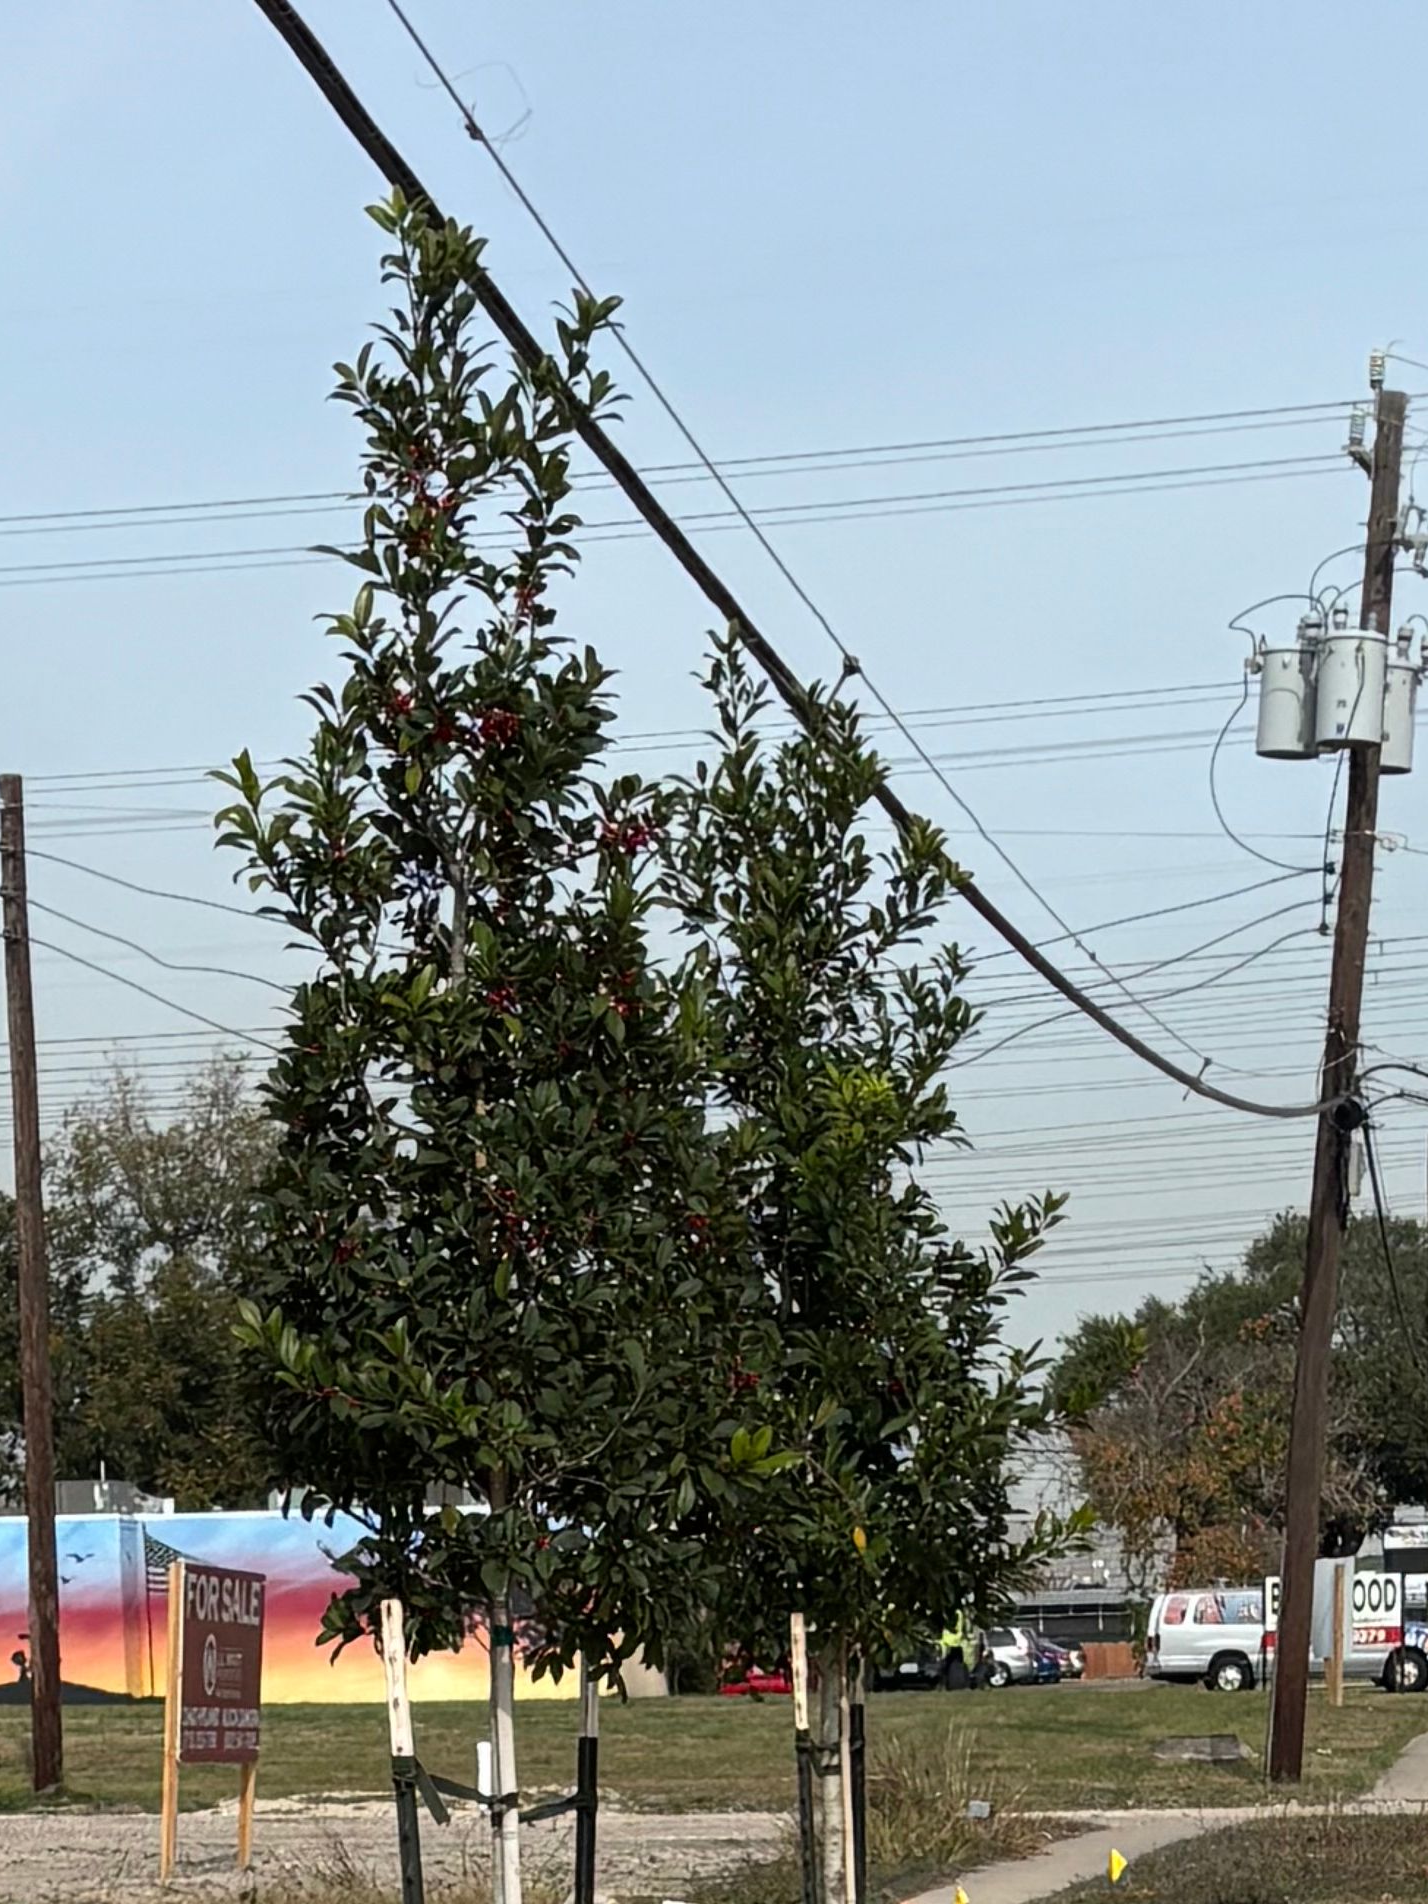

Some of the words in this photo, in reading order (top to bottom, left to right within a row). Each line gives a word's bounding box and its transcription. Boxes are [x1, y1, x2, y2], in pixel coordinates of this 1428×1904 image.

[186, 1572, 220, 1622] FOR
[221, 1577, 262, 1627] SALE
[1353, 1578, 1397, 1612] OOD
